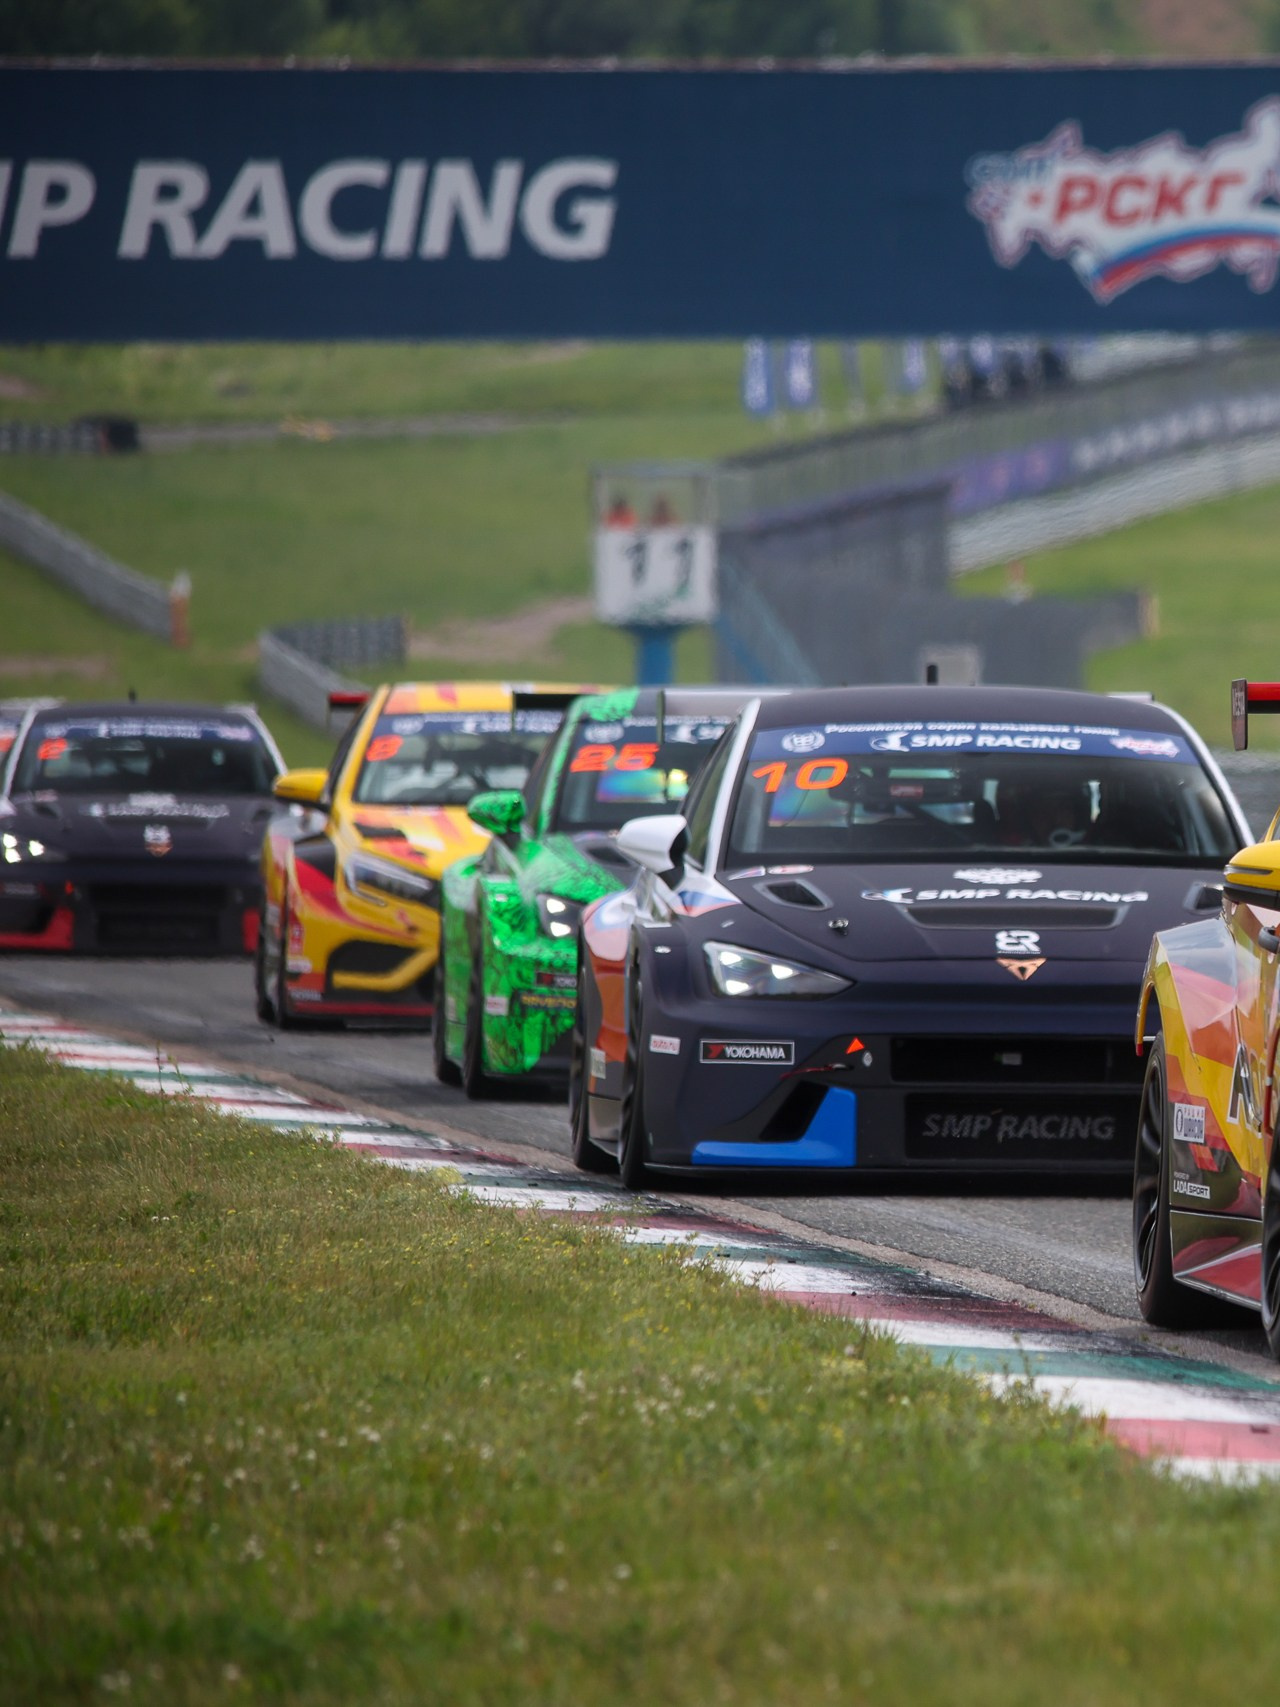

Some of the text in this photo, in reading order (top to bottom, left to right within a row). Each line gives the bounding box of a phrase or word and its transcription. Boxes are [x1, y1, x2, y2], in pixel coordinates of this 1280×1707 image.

[0, 156, 618, 261] P RACING
[1052, 172, 1246, 226] РСКГ
[911, 734, 1082, 751] SMP RACING
[752, 757, 849, 793] 10
[916, 888, 1149, 903] SMP RACING
[724, 1045, 786, 1060] YOKOHAMA
[922, 1113, 1115, 1141] SMP RACING
[1173, 1179, 1209, 1196] LADA SPORT
